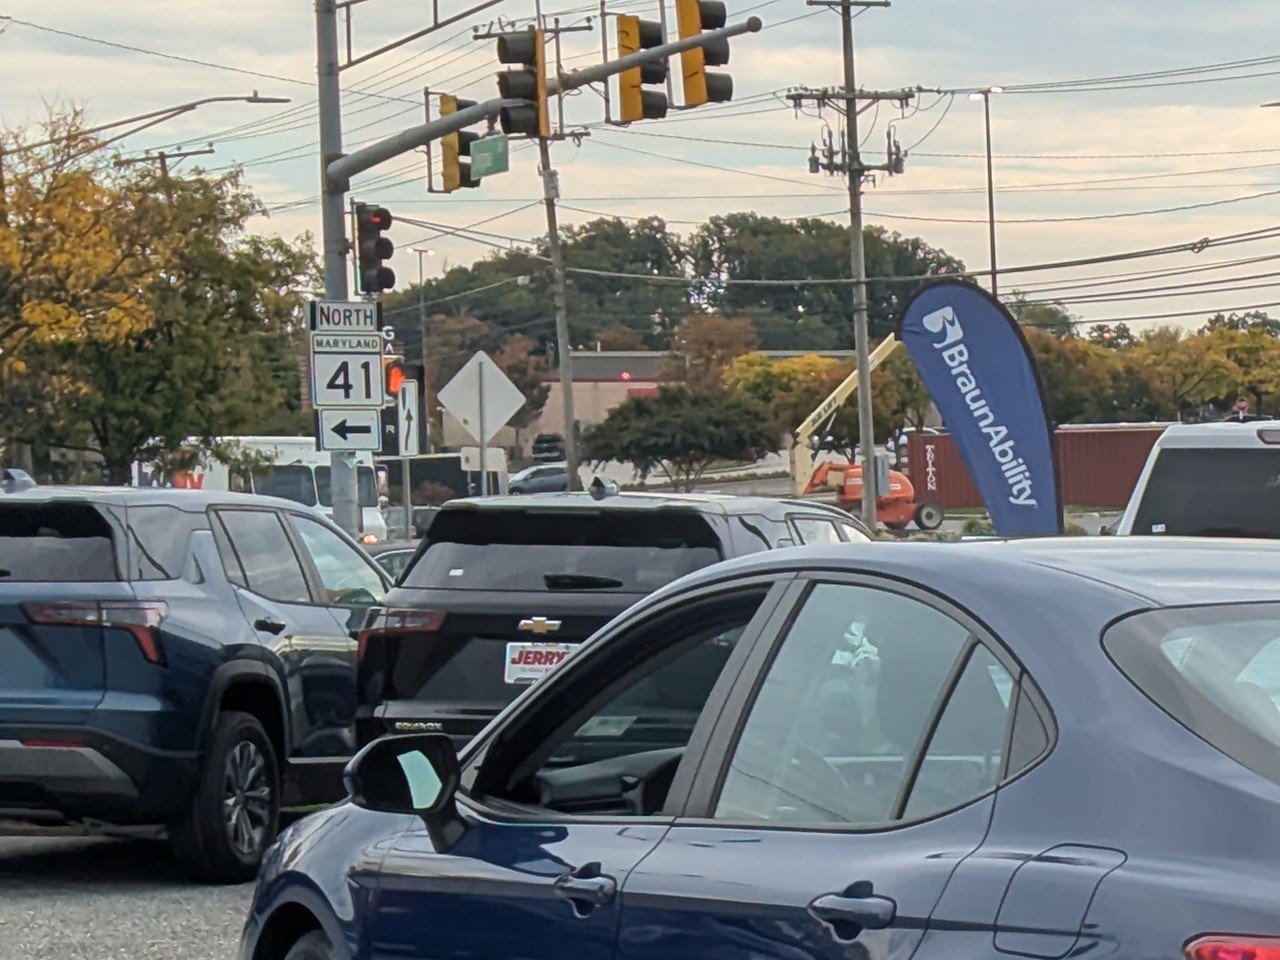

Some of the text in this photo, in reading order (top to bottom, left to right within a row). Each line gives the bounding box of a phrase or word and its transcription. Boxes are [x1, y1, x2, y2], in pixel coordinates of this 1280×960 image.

[319, 306, 374, 326] NORTH
[315, 338, 379, 350] MARYLAND
[326, 360, 372, 399] 41
[942, 342, 1040, 509] BraunAbility
[925, 444, 937, 491] TRITON
[511, 650, 569, 665] JERRY
